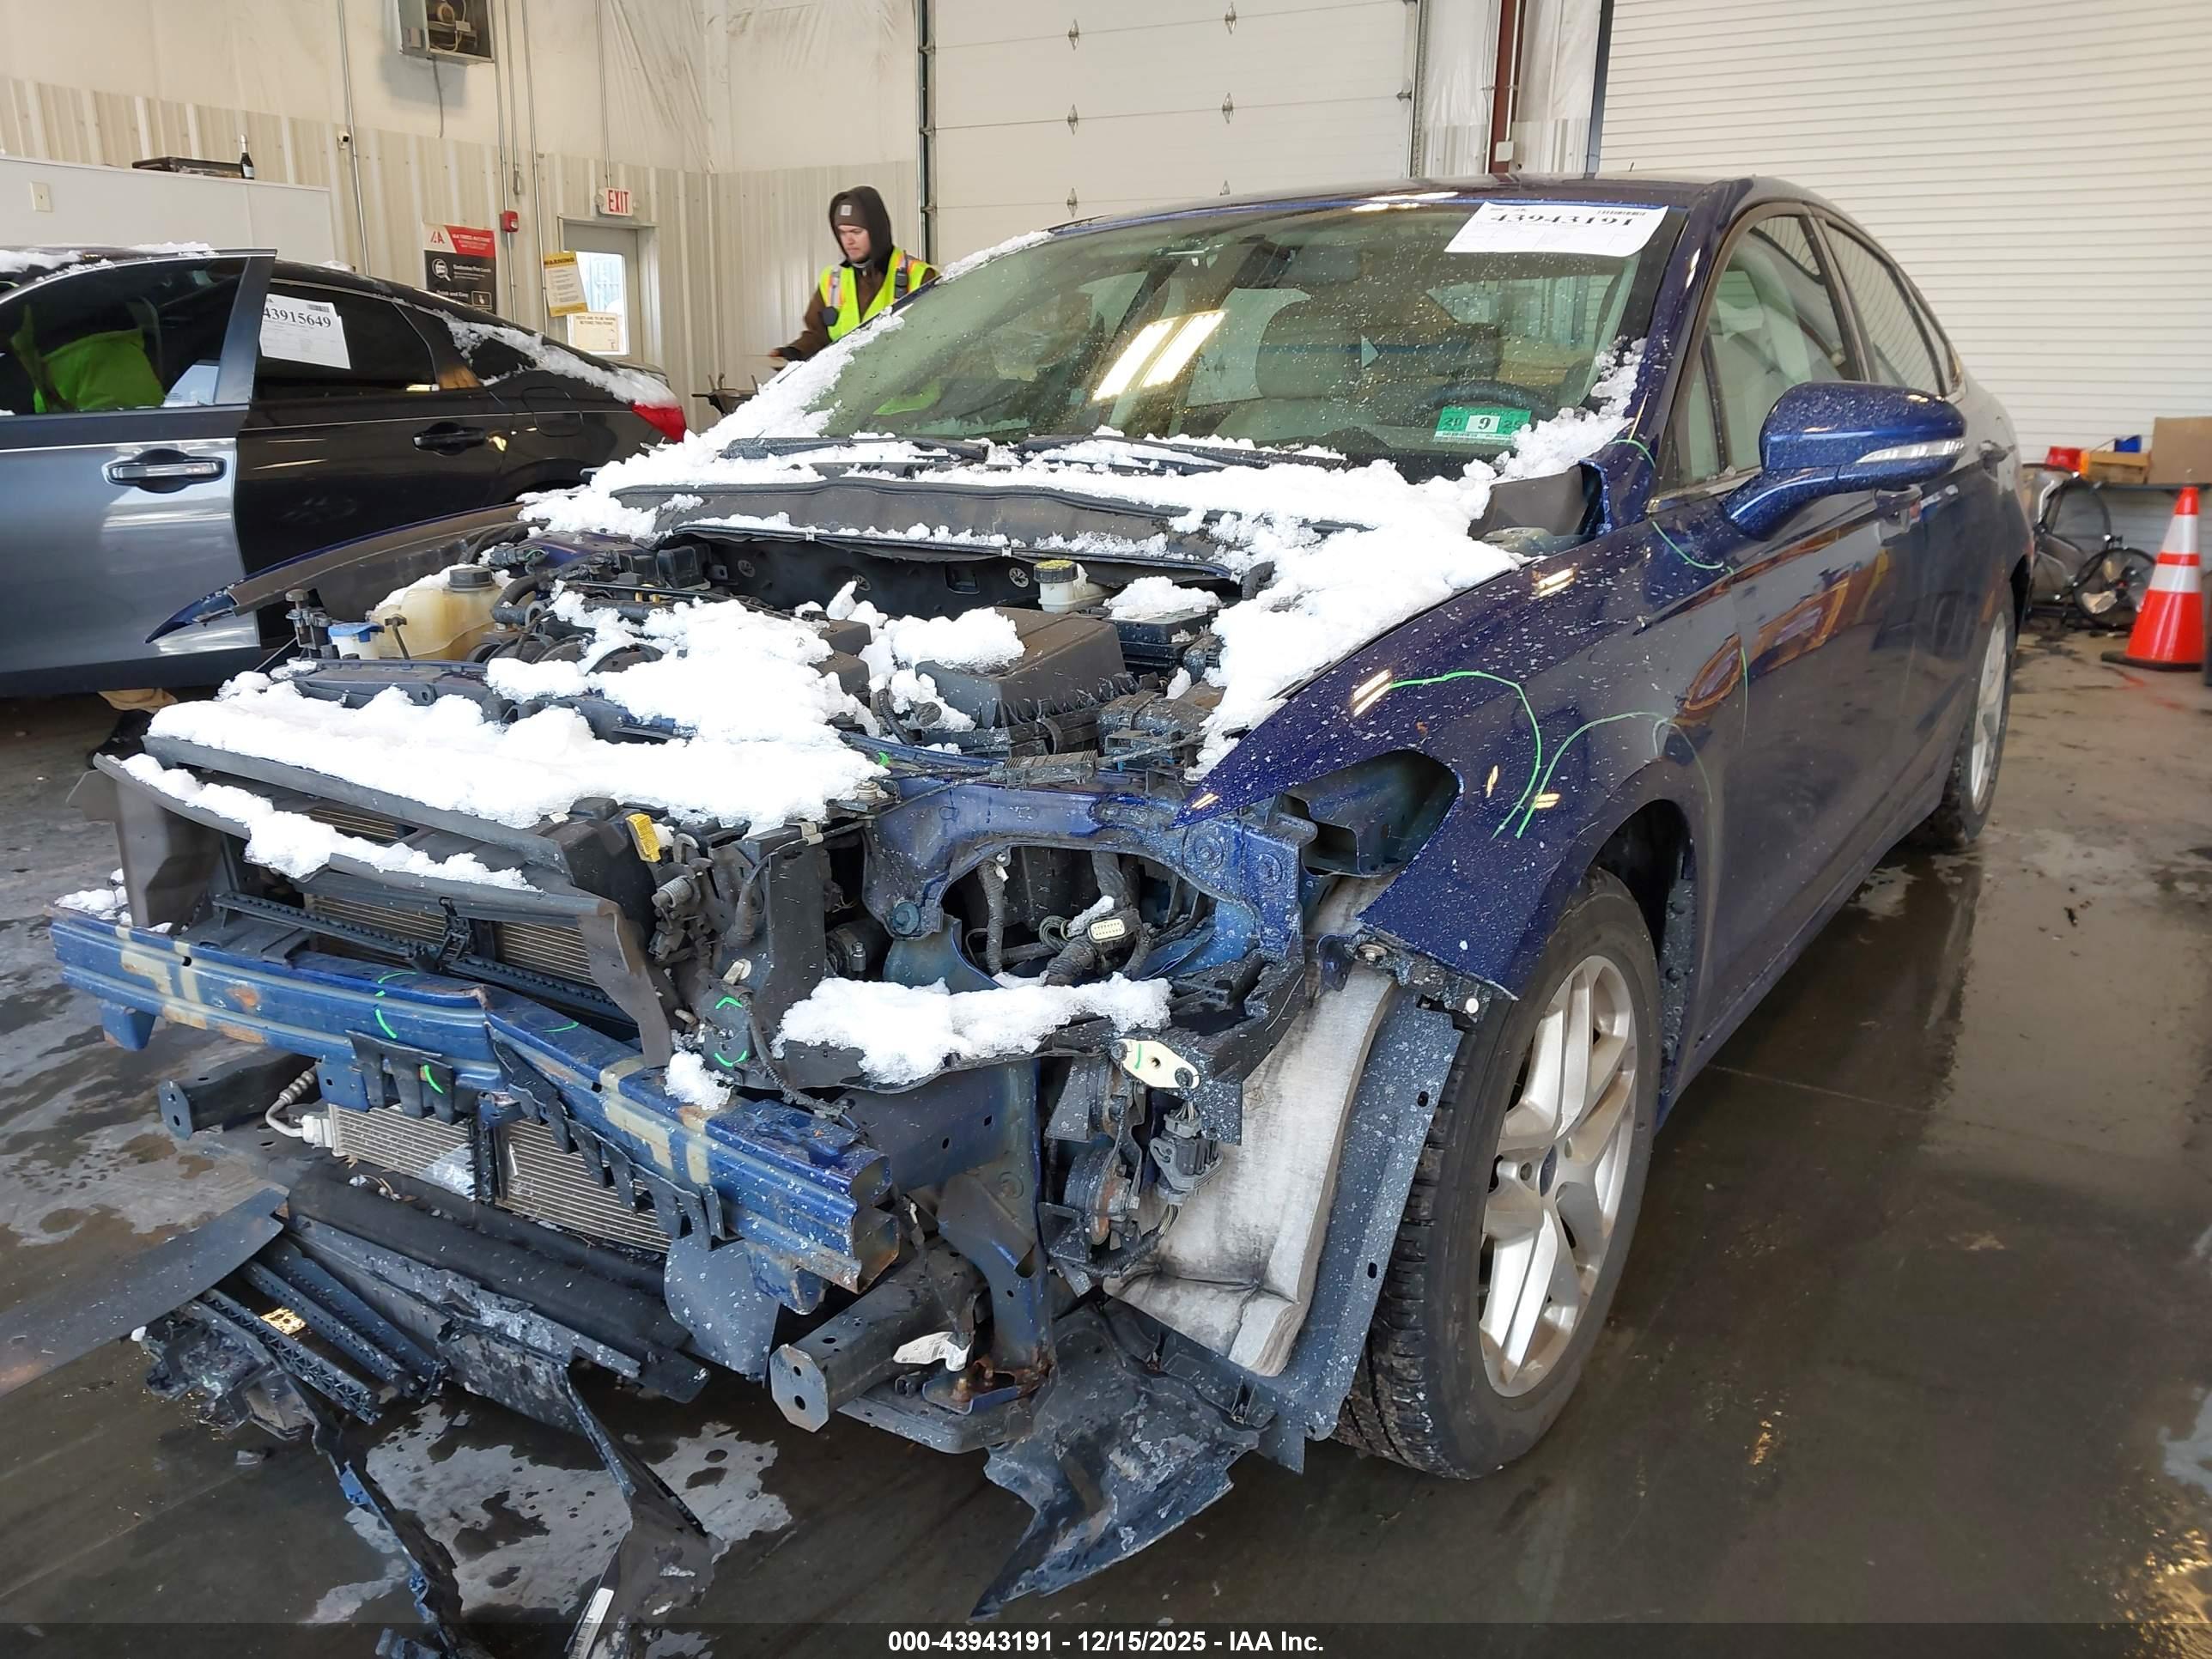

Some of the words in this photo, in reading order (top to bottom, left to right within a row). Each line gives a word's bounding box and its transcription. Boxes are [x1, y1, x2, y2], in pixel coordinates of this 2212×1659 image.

[608, 190, 629, 213] EXIT
[1491, 213, 1635, 226] 43943191
[544, 257, 575, 265] WARNING
[262, 307, 331, 328] 43915649
[1478, 417, 1491, 429] 9
